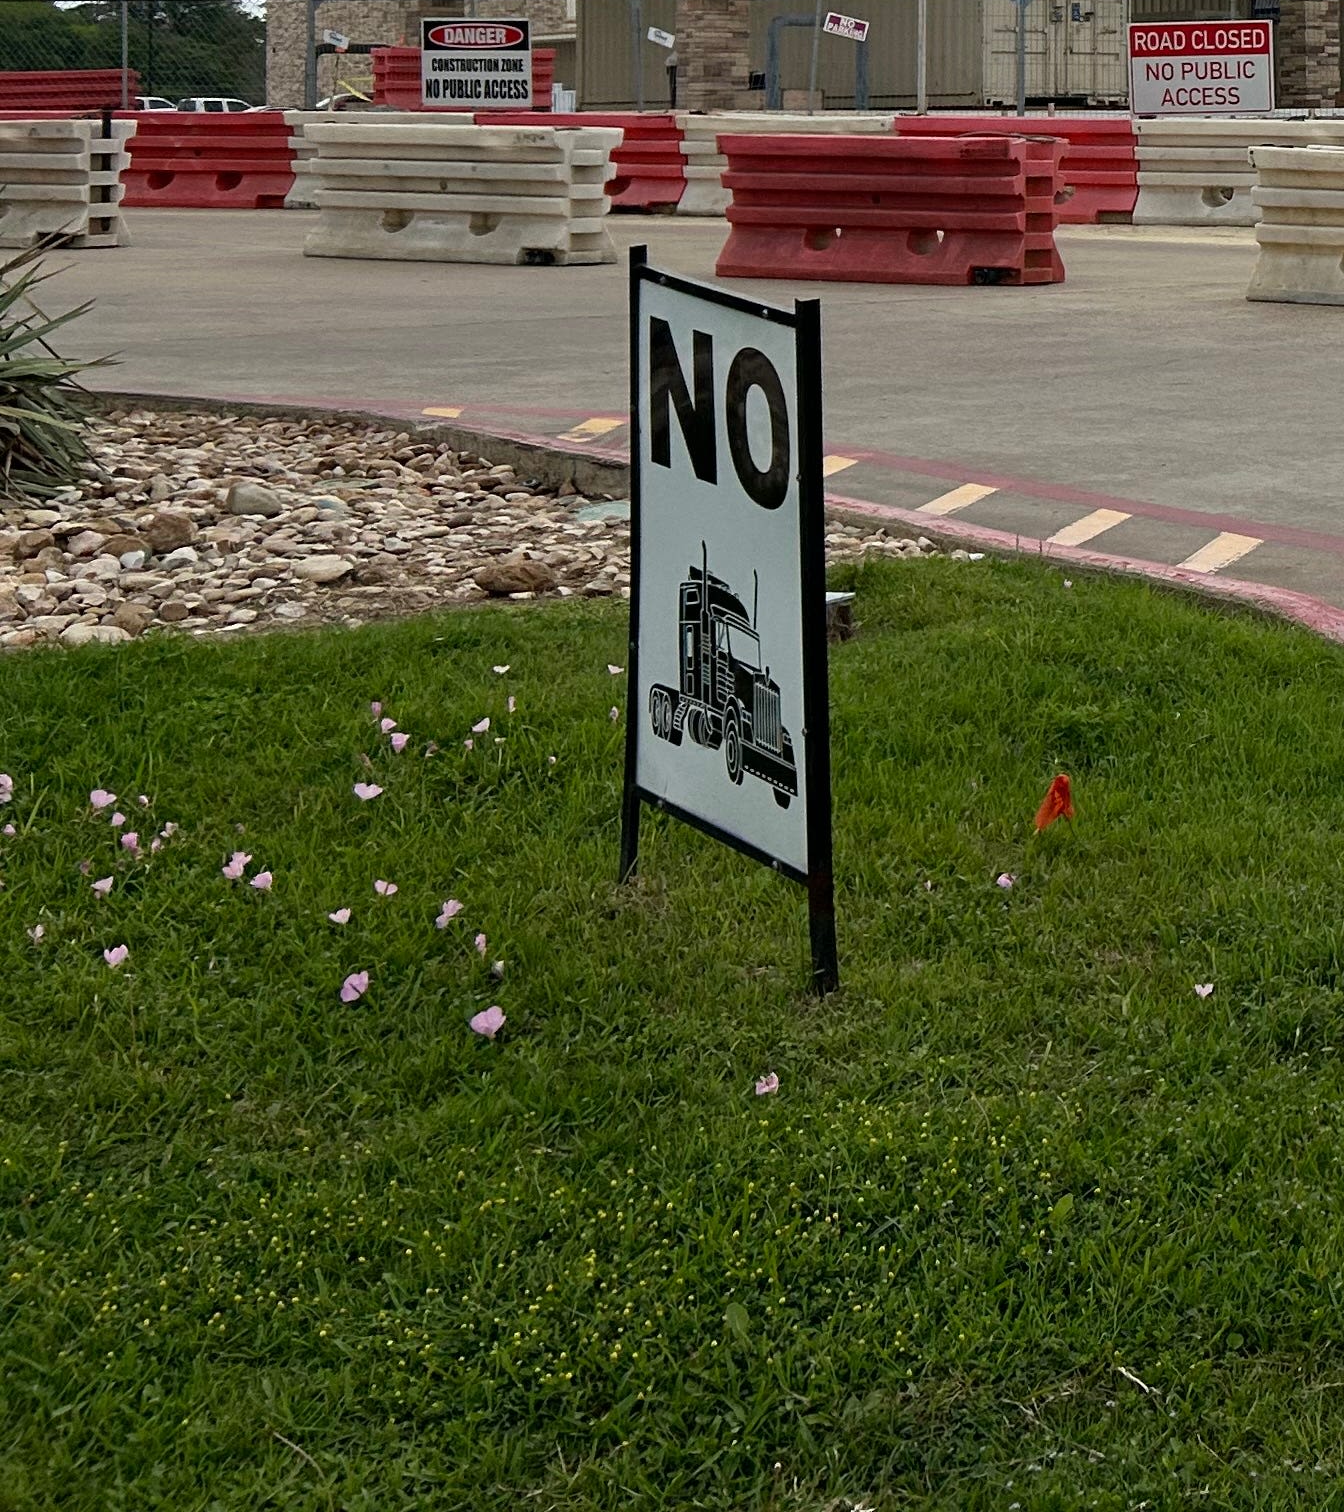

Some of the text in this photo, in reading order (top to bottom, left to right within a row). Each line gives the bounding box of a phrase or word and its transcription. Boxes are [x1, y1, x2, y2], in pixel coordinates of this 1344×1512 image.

[827, 23, 863, 37] PARKING
[840, 18, 855, 29] NO
[444, 28, 506, 44] DANGER
[1135, 29, 1265, 51] ROAD CLOSED
[432, 58, 524, 72] CONSTRUCTION ZONE
[1146, 61, 1256, 81] NO PUBLIC
[426, 79, 528, 99] NO PUBLIC ACCESS
[1161, 87, 1240, 106] ACCESS
[650, 315, 791, 510] NO
